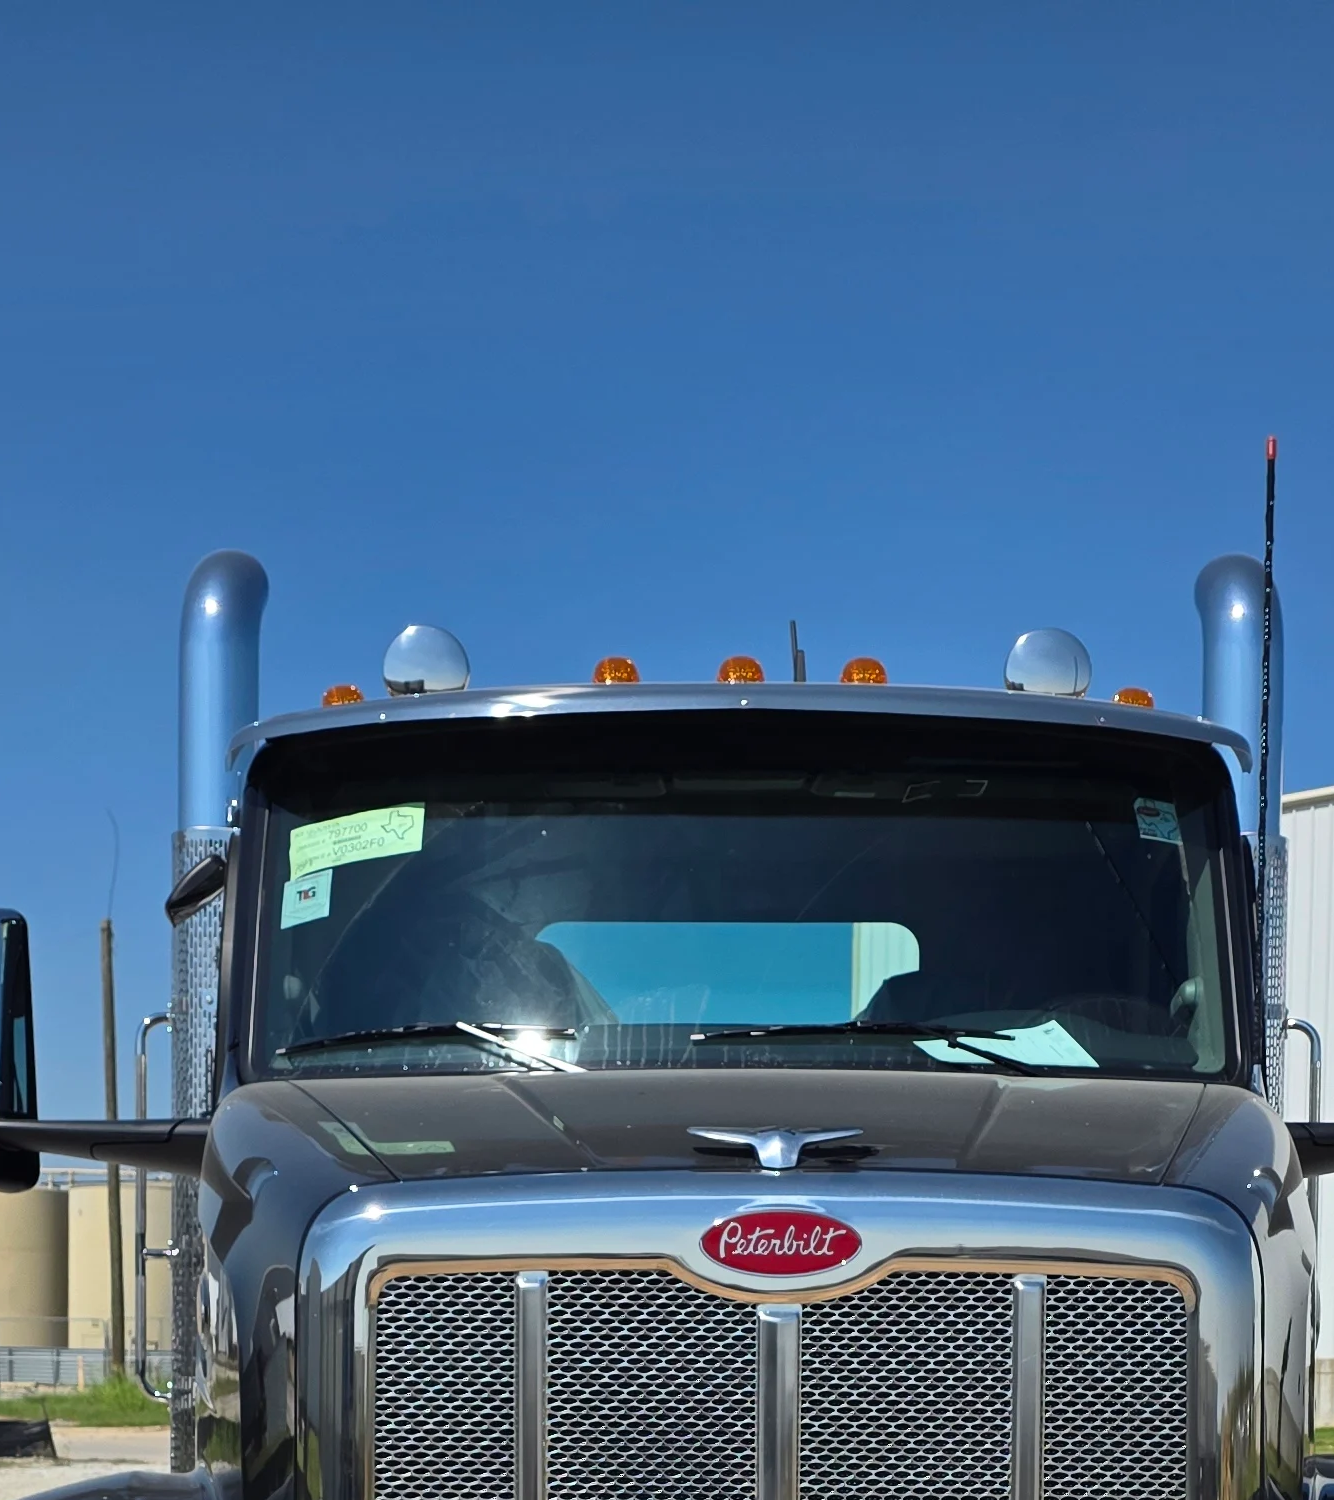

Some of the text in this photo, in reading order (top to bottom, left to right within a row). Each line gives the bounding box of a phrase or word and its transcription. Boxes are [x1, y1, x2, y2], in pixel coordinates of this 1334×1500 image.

[329, 822, 368, 840] 797700
[332, 836, 386, 856] V0302F0
[719, 1222, 847, 1258] Peterbilt
